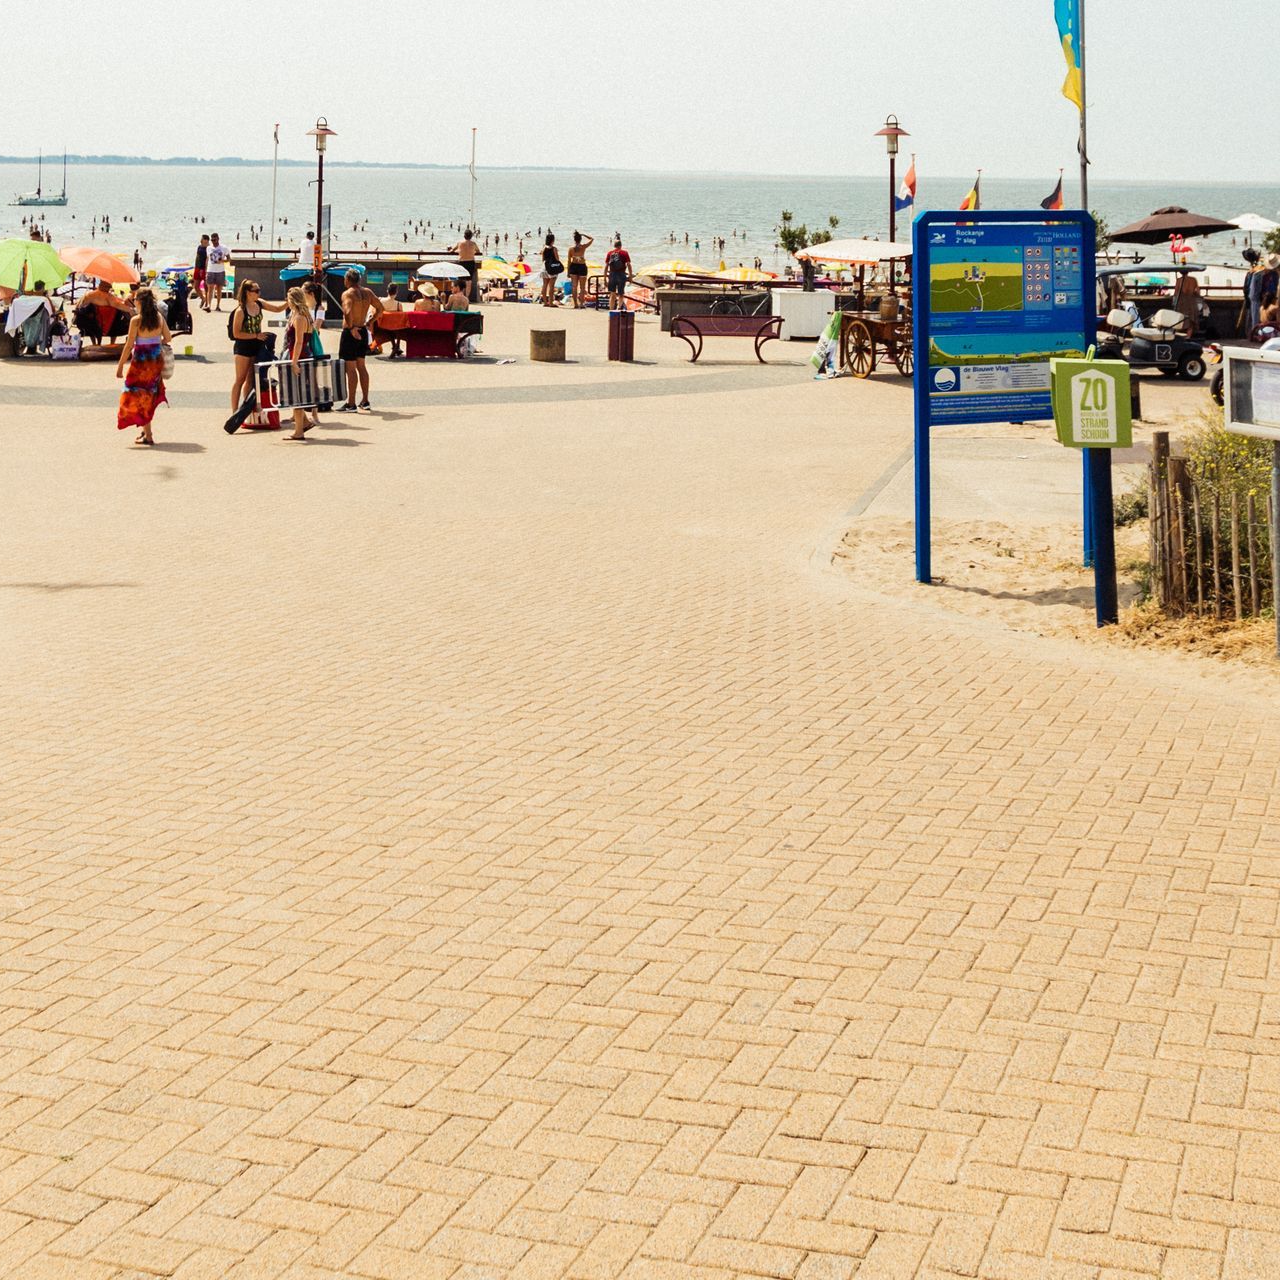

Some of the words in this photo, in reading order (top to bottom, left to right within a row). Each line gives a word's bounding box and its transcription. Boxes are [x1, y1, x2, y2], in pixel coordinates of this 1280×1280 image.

[956, 229, 985, 237] Rockanje
[963, 236, 977, 245] slag
[995, 365, 1009, 373] Vlag
[1079, 377, 1108, 411] ZO
[1080, 418, 1109, 428] STRAND
[1081, 429, 1109, 439] SCHOON
